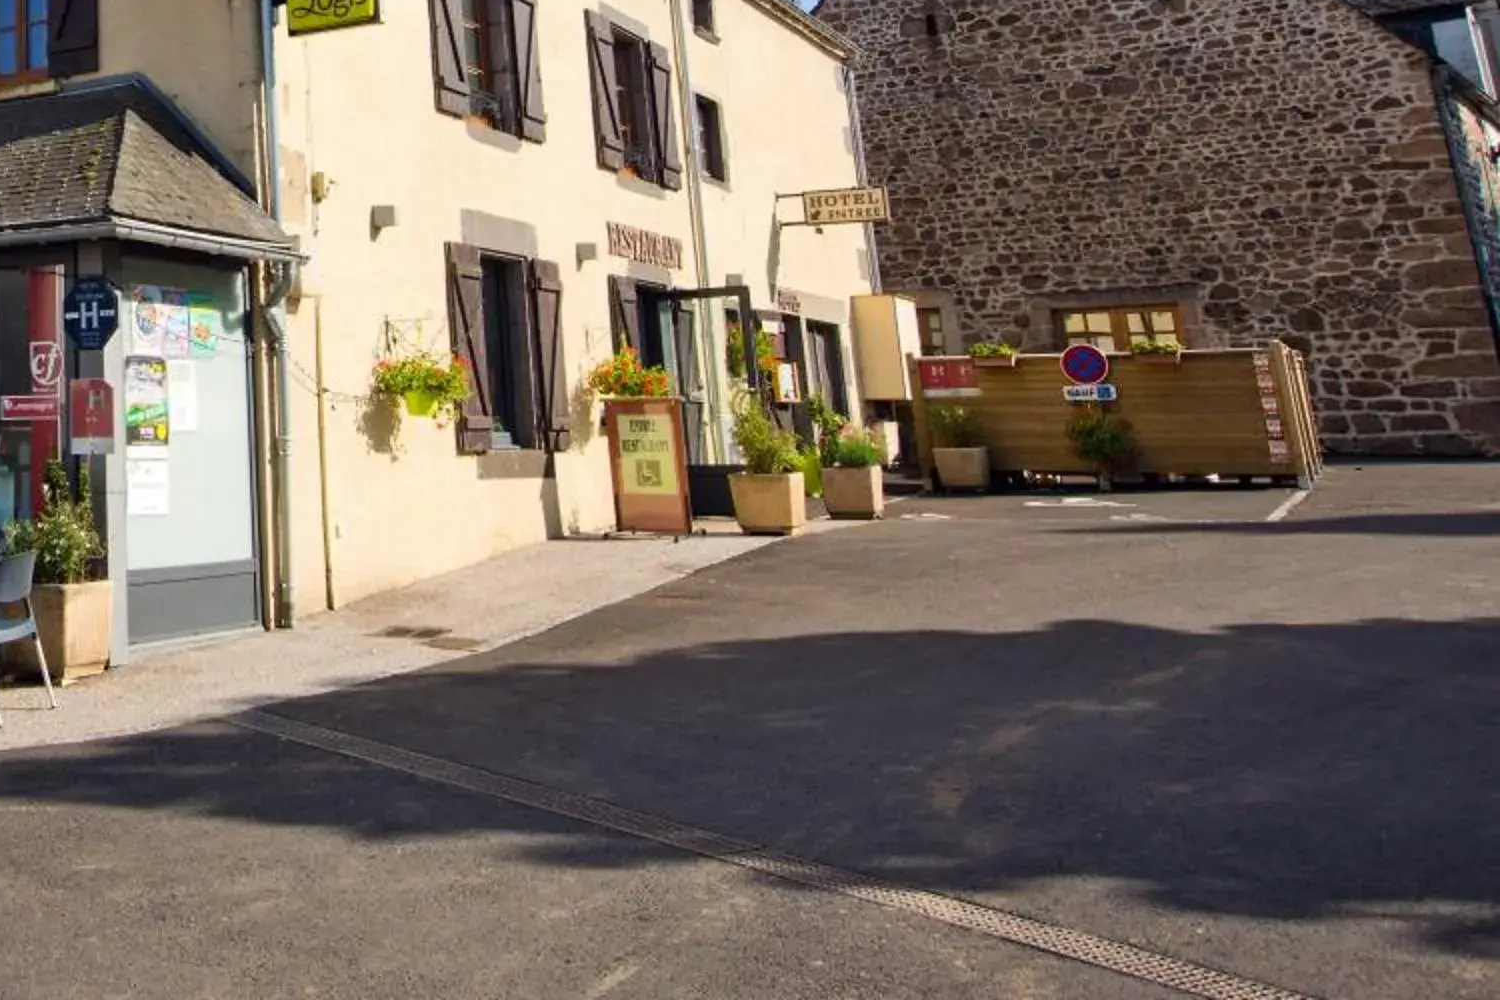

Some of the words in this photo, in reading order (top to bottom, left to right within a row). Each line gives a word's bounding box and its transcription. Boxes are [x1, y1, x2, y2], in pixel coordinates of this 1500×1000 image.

[808, 191, 880, 209] HOTEL
[80, 301, 100, 330] H
[88, 389, 105, 411] H
